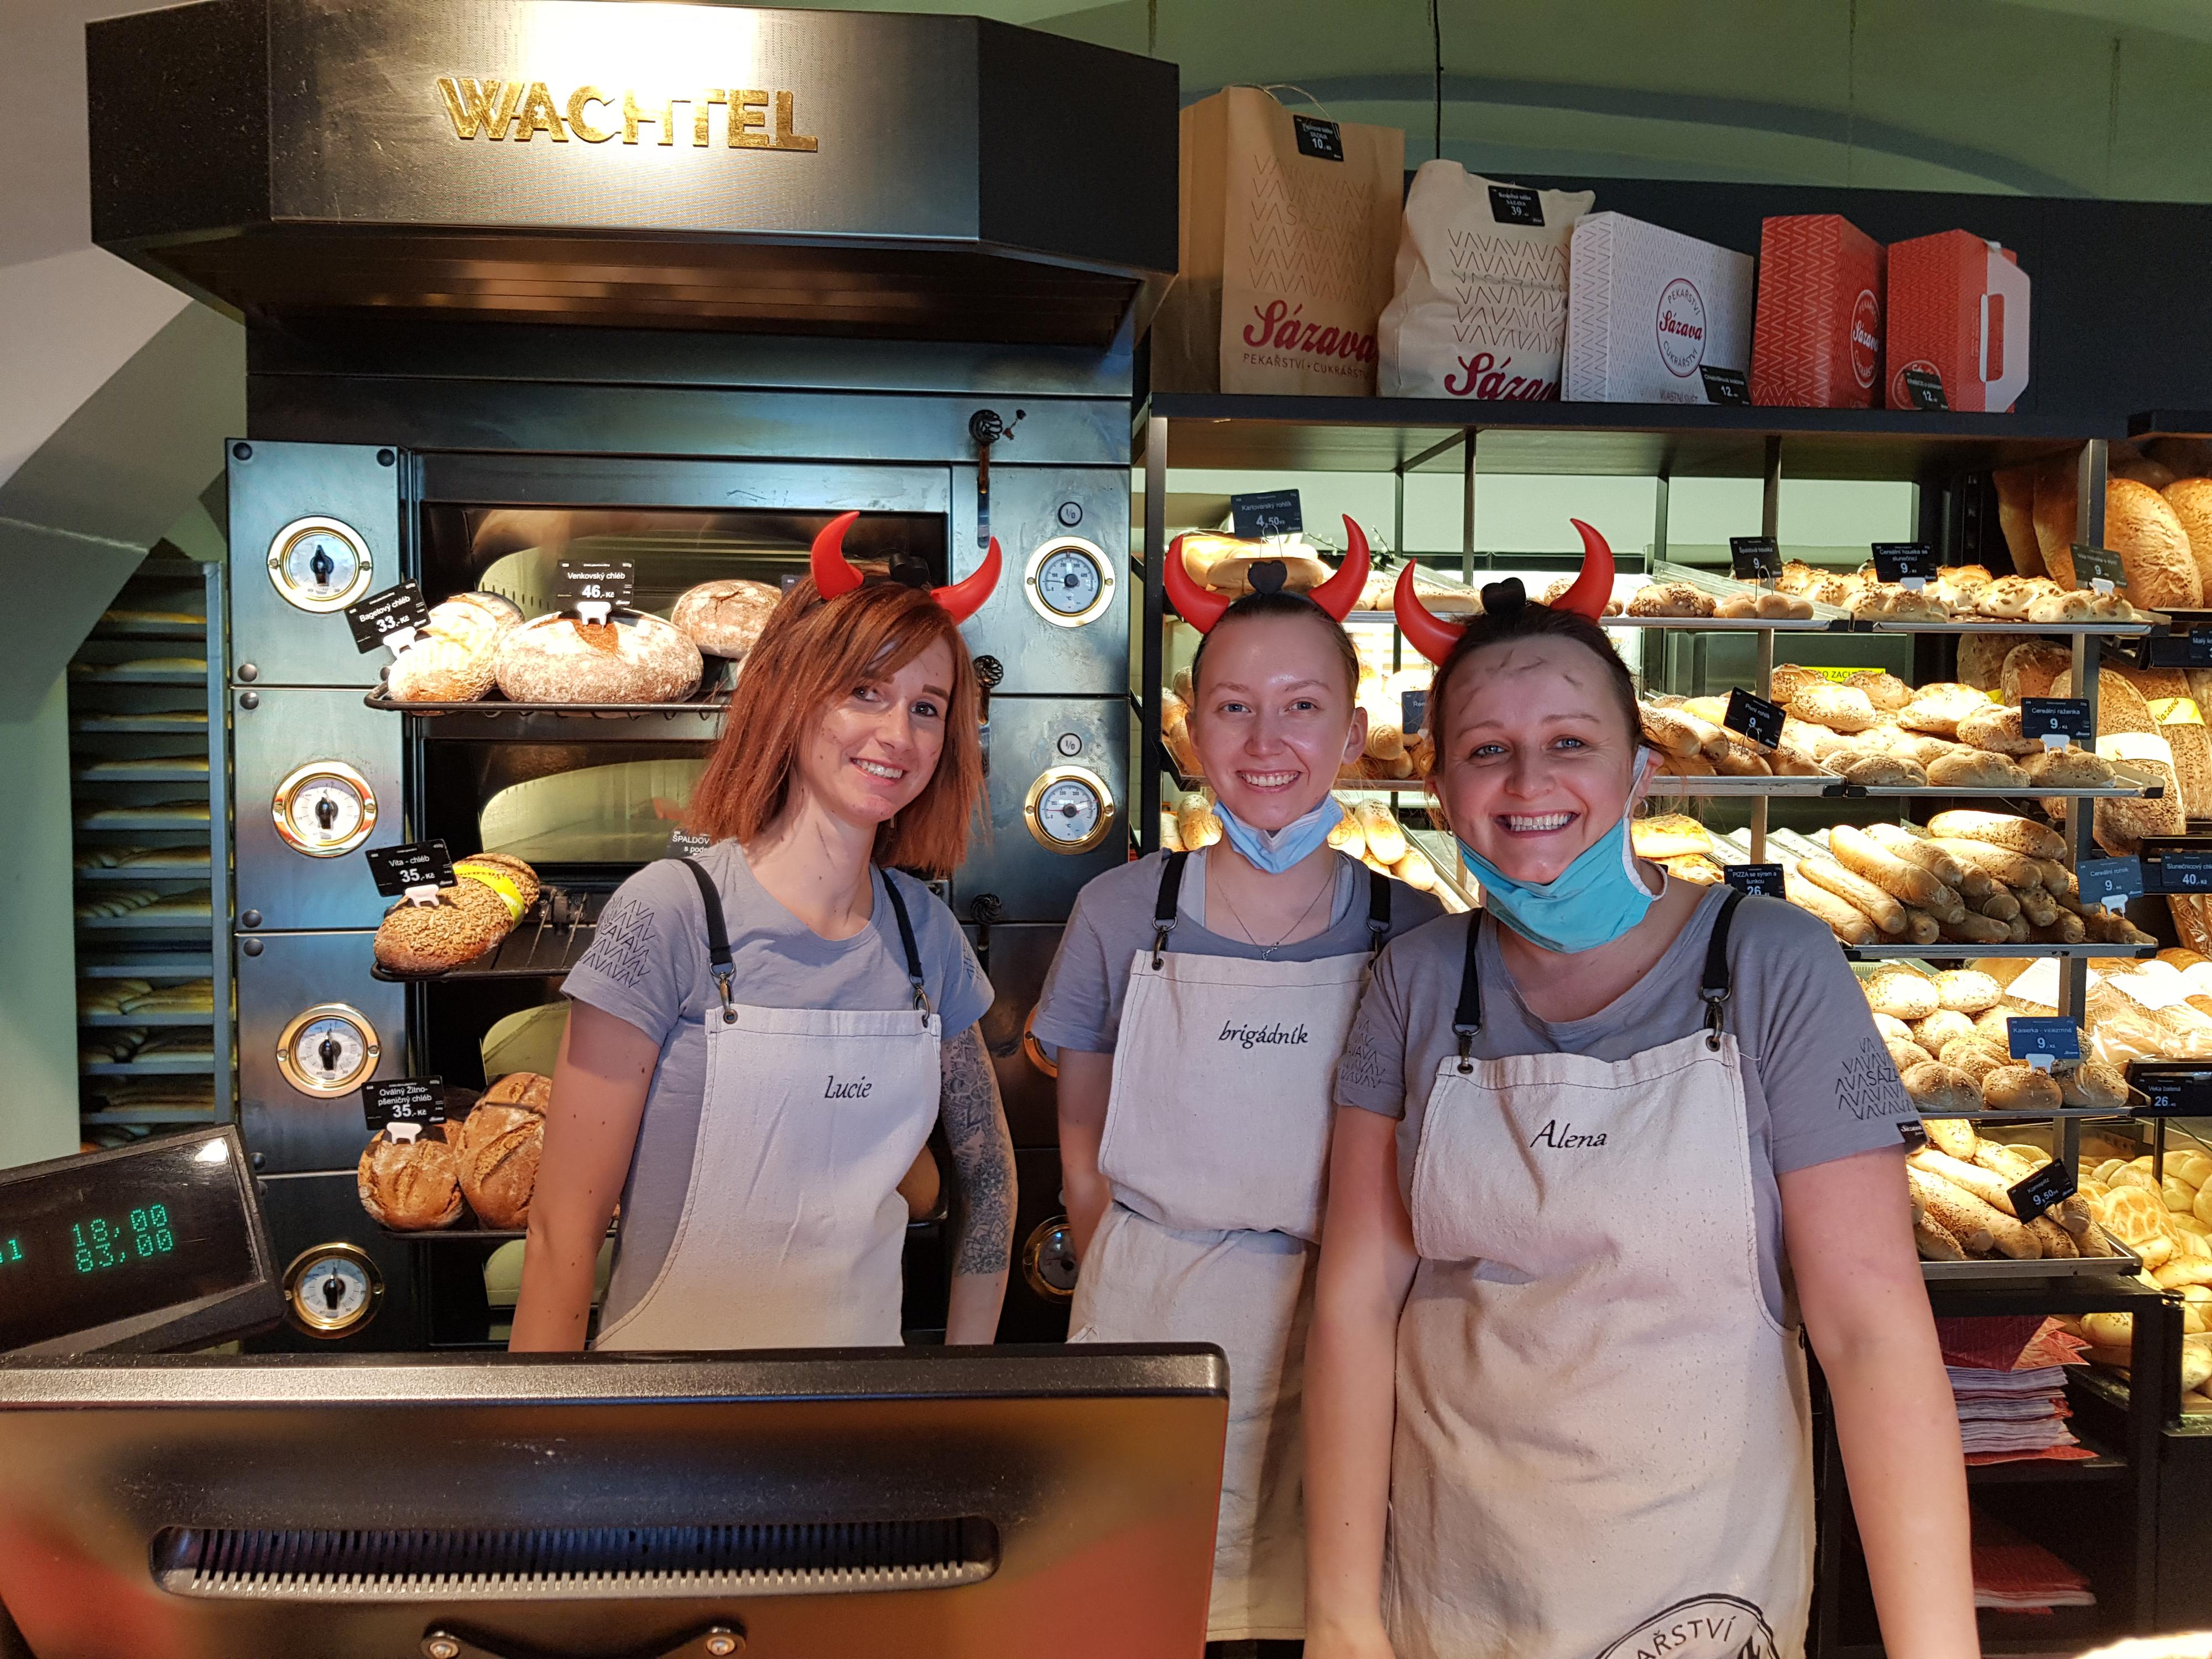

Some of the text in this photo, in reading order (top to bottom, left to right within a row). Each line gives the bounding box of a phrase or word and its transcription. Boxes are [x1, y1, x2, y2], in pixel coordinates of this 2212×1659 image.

[436, 77, 818, 152] WACHTEL
[1667, 288, 1701, 316] PEKAŘSTVÍ
[1243, 299, 1379, 364] Sázava
[1659, 310, 1703, 341] Sázava
[1243, 353, 1368, 380] PEKAŘSTVÍ CUKRÁŘSTV
[567, 572, 606, 581] Venkovský
[359, 603, 392, 623] Bagetový
[392, 595, 411, 608] chléb
[672, 834, 710, 845] ŠPALDOV
[410, 854, 430, 864] chléb
[1218, 1020, 1308, 1050] brigádník
[378, 1094, 432, 1107] pšeničný chléb
[379, 1086, 429, 1097] Oválný Žitno-
[824, 1075, 873, 1099] Lucie
[1529, 1119, 1608, 1149] Alena
[1636, 1615, 1737, 1659] AŘSTVÍ
